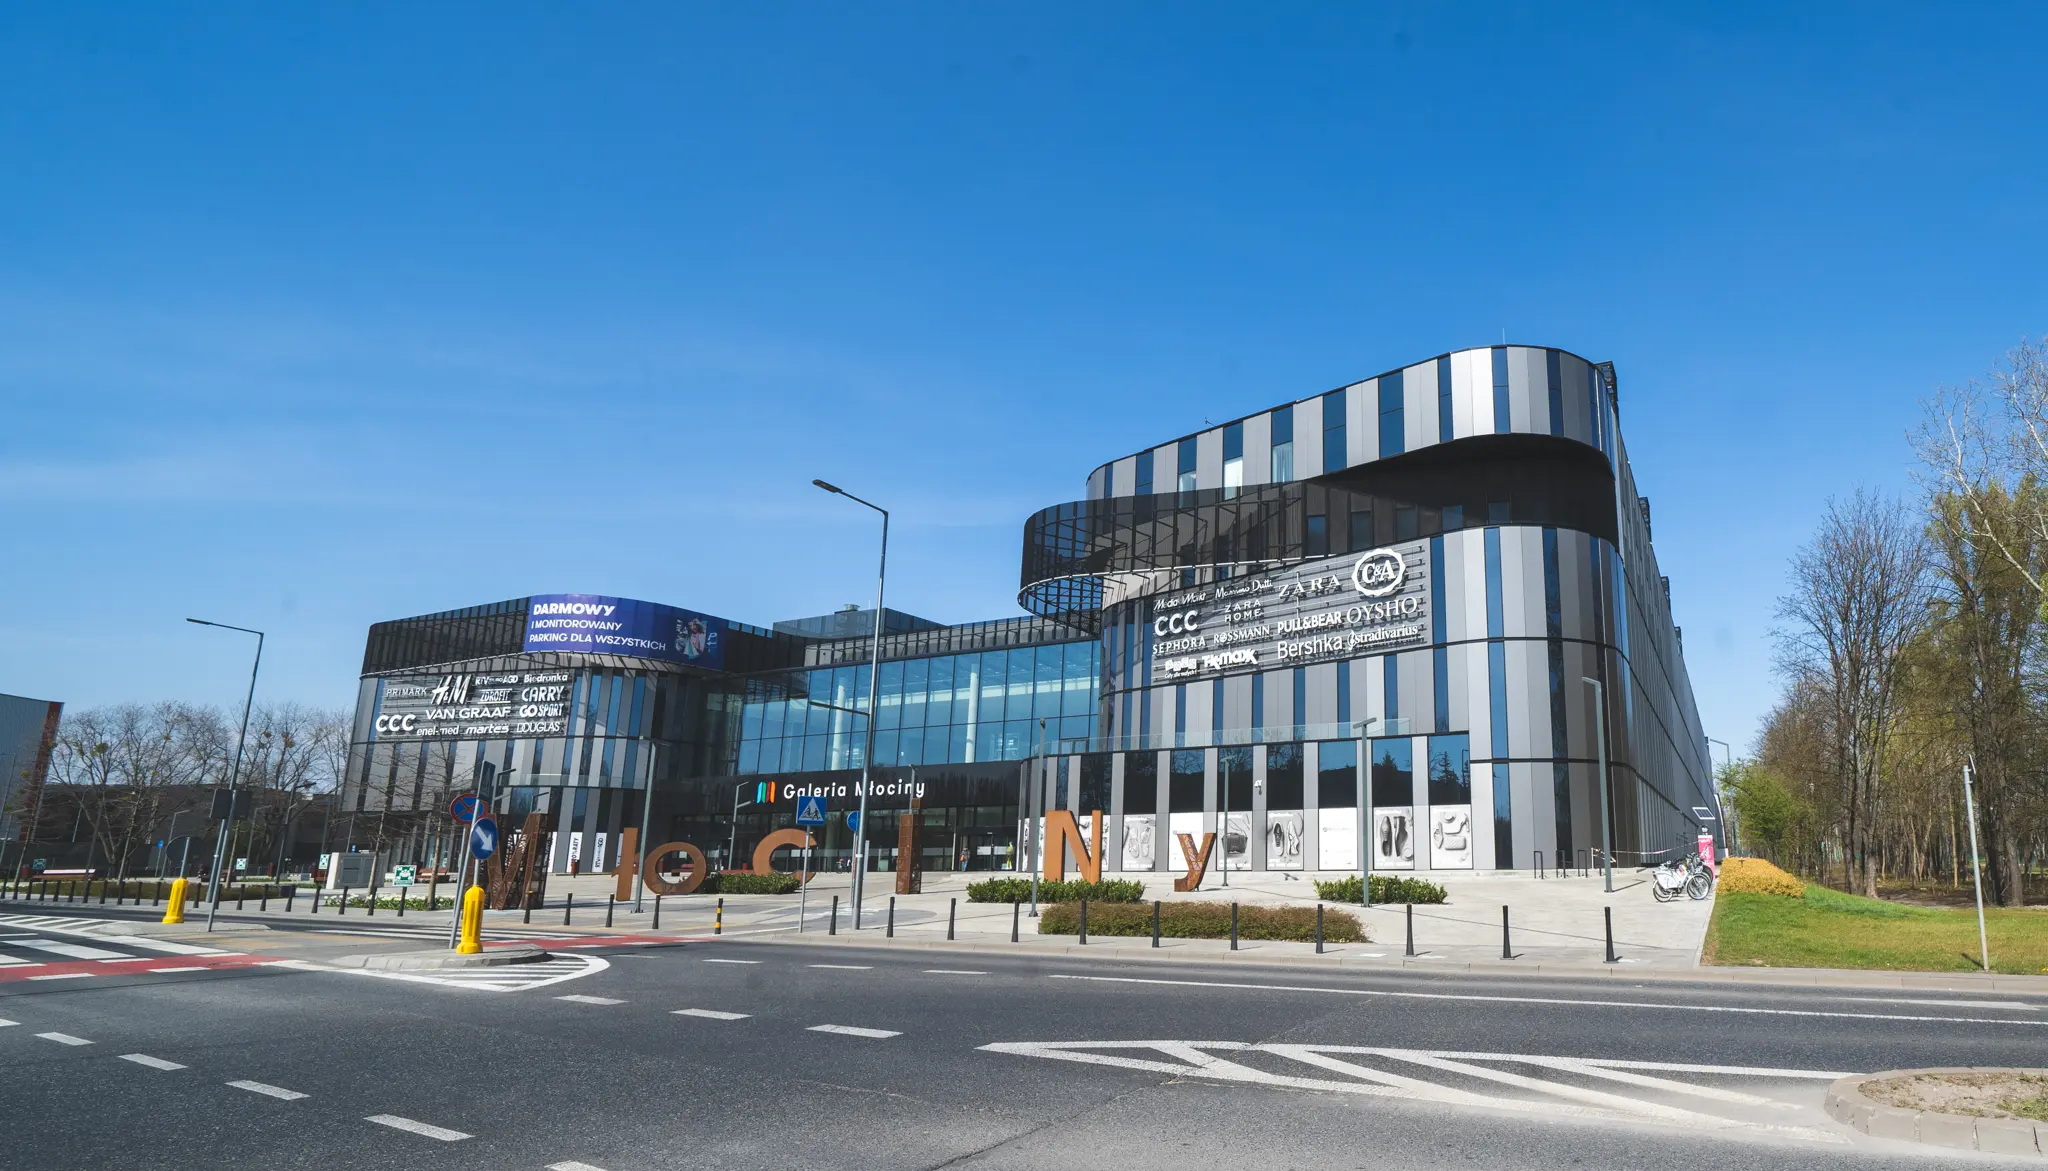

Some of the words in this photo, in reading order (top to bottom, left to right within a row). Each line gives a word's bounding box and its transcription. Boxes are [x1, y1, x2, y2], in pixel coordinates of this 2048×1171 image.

[1362, 560, 1396, 584] C&A
[1252, 579, 1273, 592] Dutti
[1279, 574, 1341, 598] ZARA
[533, 603, 615, 616] DARMOWY
[1225, 599, 1261, 613] ZARA
[1347, 596, 1417, 624] OYSHO
[1154, 610, 1198, 636] CCC
[1224, 608, 1262, 622] HOME
[1277, 611, 1342, 634] PULL&BEAR
[535, 619, 622, 631] MONITOROWANY
[529, 632, 568, 643] PARKING
[570, 633, 592, 643] DLA
[596, 635, 666, 651] WSZYSTKICH
[1213, 625, 1270, 644] ROSSMANN
[1152, 636, 1205, 654] SEPHORA
[1277, 634, 1343, 659] Bershka
[386, 687, 427, 696] PRIMARK
[431, 674, 472, 705] H&M
[521, 685, 564, 702] CARRY
[425, 708, 455, 720] VAN
[459, 706, 511, 719] GRAAF
[519, 704, 538, 718] GO
[538, 703, 564, 717] SPORT
[375, 714, 416, 732] CCC
[417, 725, 459, 736] enel-med
[465, 724, 509, 735] martes
[516, 721, 560, 733] DOUGLAS
[784, 782, 846, 799] Galeria
